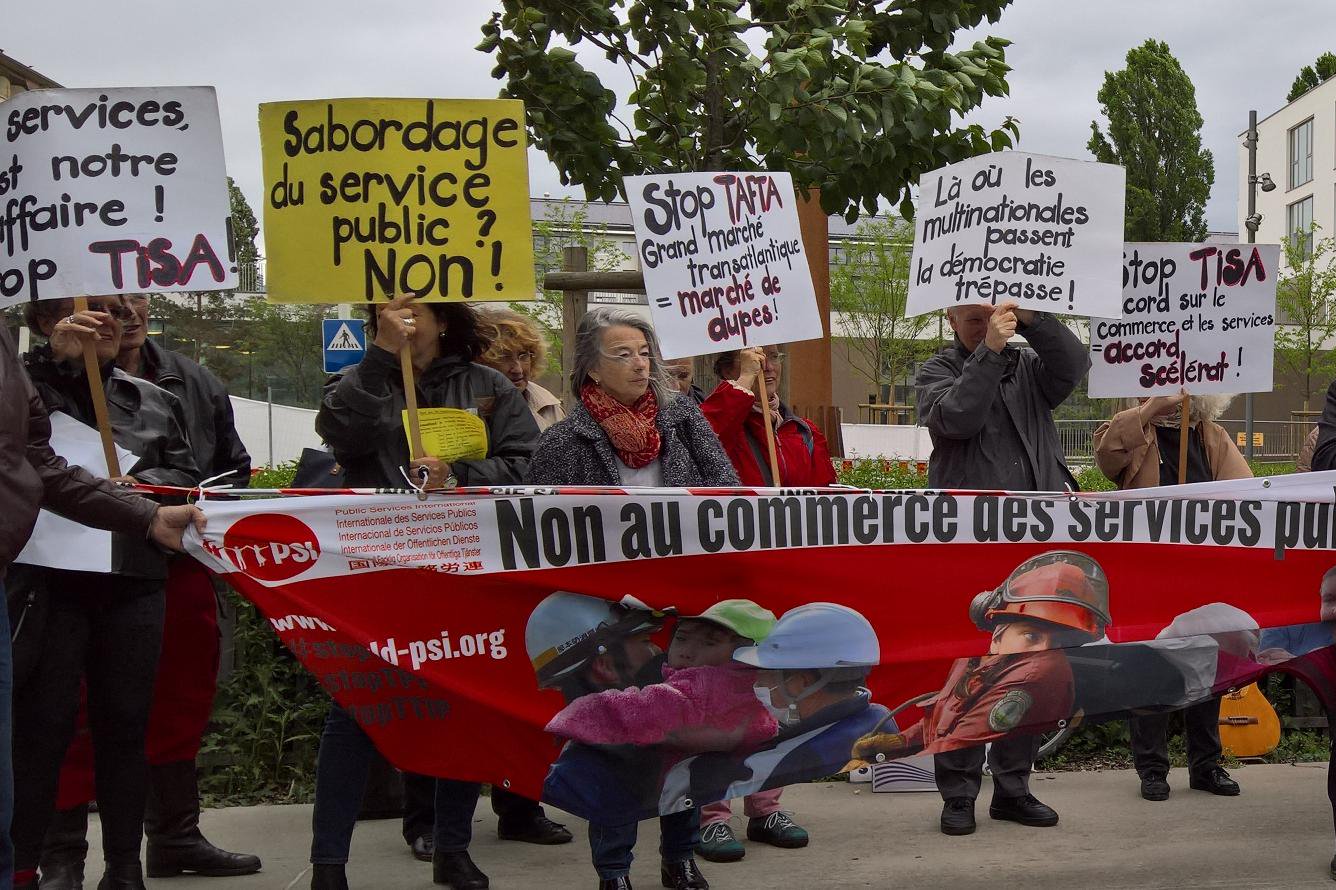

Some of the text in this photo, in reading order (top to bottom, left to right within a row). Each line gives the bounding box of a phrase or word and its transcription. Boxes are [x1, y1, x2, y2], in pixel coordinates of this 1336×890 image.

[7, 95, 189, 142] services,
[284, 100, 519, 170] Sabordage
[52, 143, 178, 181] notre
[271, 162, 491, 209] du service
[934, 158, 1056, 208] Là où les
[0, 193, 128, 257] ffaire
[643, 174, 783, 238] Stop TAFTA
[922, 193, 1089, 243] multinationales
[333, 202, 497, 266] public ?
[642, 214, 764, 268] Grand marché
[983, 226, 1075, 258] passent
[364, 240, 503, 300] Non !
[687, 238, 800, 287] transatlantique
[917, 243, 1065, 286] la démocratie
[1189, 247, 1266, 290] TiSA
[677, 273, 755, 317] marché
[761, 265, 781, 296] de
[1122, 282, 1226, 314] cord sur le
[1097, 313, 1274, 340] commerce et les services
[1139, 350, 1229, 388] scélérat
[335, 501, 477, 516] Public Services International
[336, 507, 477, 529] Internationale des Services Publics
[339, 528, 391, 541] Internacional
[393, 527, 404, 536] de
[405, 525, 443, 536] Servicios
[341, 541, 392, 554] Internationale
[393, 540, 406, 550] der
[452, 535, 480, 545] Dienste
[495, 497, 606, 570] Non
[620, 501, 683, 559] au
[697, 495, 958, 554] commerce
[973, 496, 1055, 543] des
[1067, 497, 1262, 547] services
